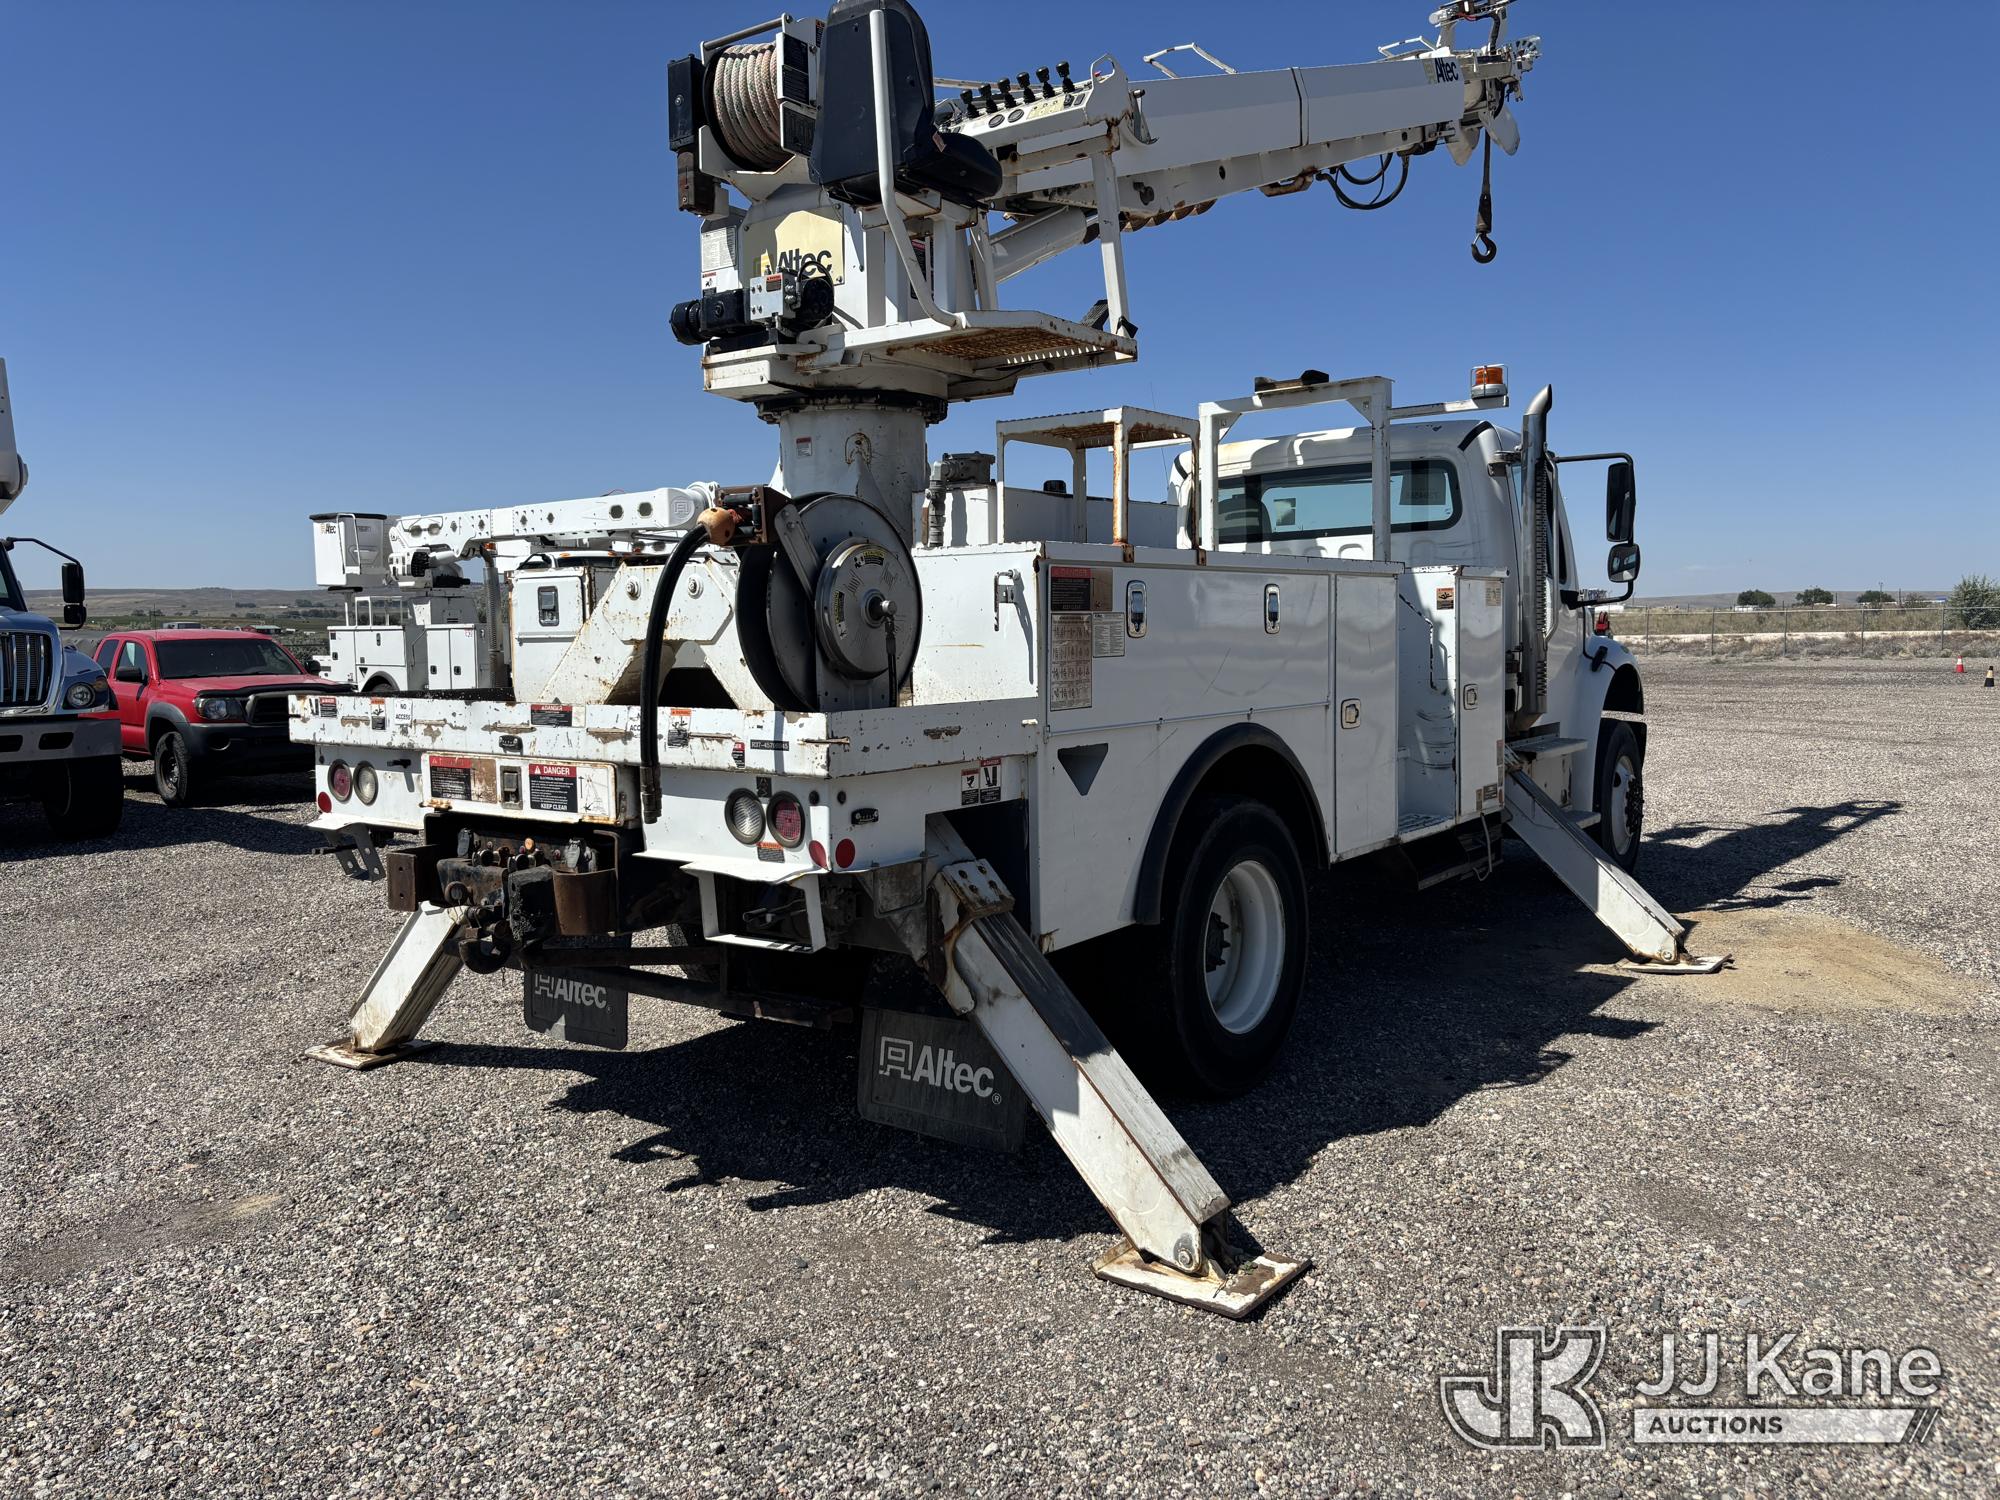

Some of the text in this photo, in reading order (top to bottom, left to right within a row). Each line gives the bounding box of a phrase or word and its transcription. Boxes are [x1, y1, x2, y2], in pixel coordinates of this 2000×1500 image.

[1434, 57, 1459, 83] Altec
[543, 765, 570, 775] DANGER
[553, 803, 568, 811] CLEAR
[912, 1045, 995, 1098] Altec
